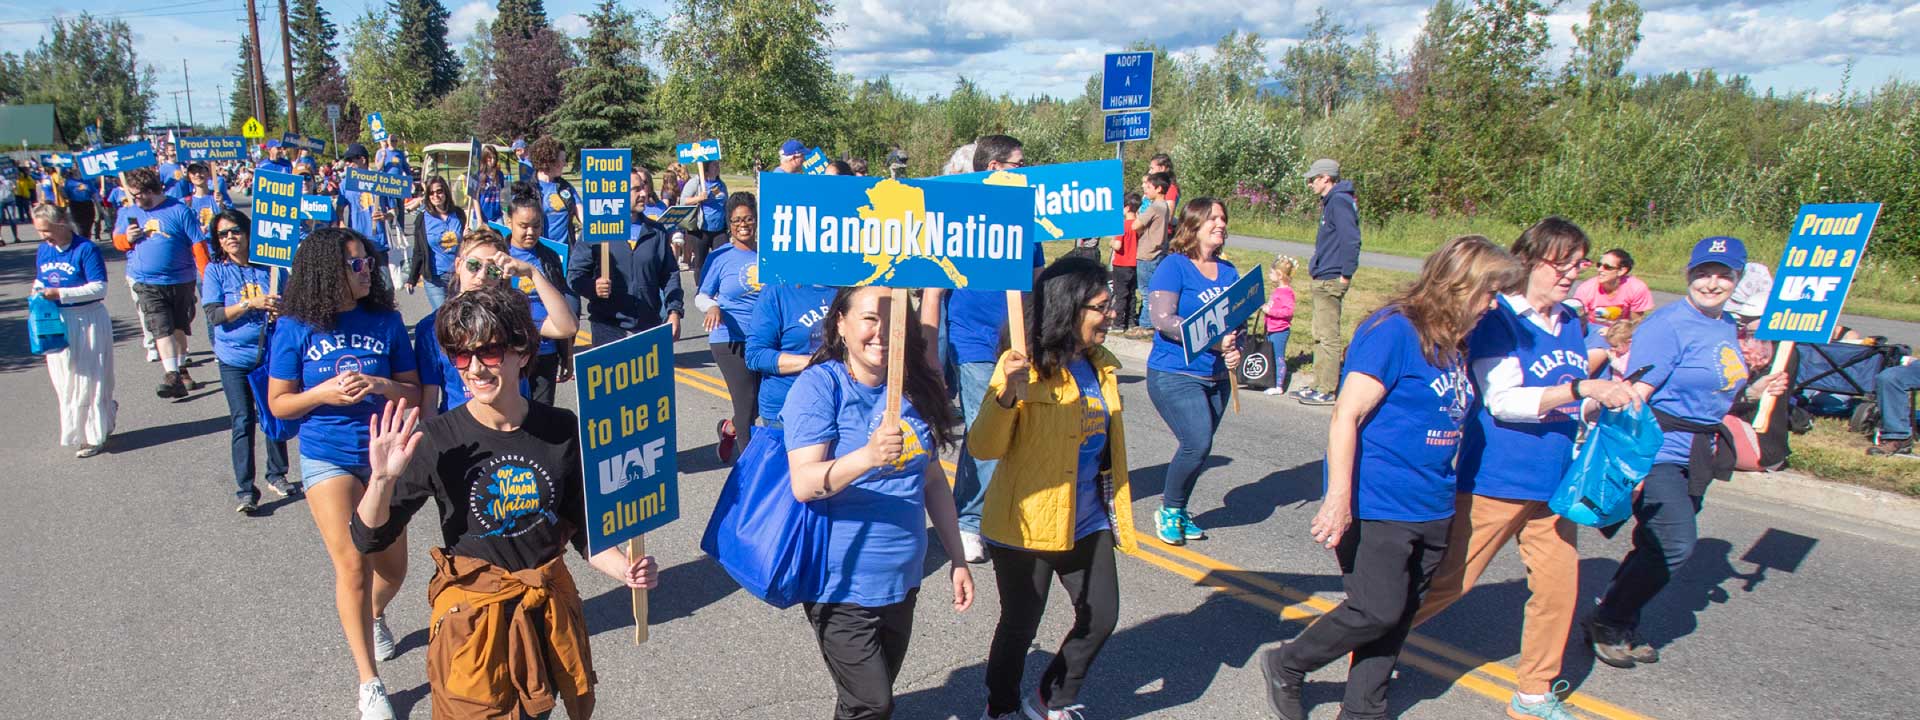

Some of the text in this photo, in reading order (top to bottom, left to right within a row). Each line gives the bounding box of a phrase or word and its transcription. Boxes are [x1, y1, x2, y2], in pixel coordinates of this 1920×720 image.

[1116, 55, 1142, 68] ADOPT
[1125, 75, 1131, 88] A
[1110, 94, 1144, 108] HIGHWAY
[1112, 115, 1142, 127] Fairbanks
[1129, 126, 1148, 137] Lions
[180, 139, 209, 148] Proud
[211, 140, 220, 148] to
[222, 139, 234, 148] be
[209, 148, 237, 158] Alum!
[81, 151, 119, 175] UAF
[586, 156, 623, 171] Proud
[258, 176, 295, 197] Proud
[351, 170, 378, 182] Proud
[380, 175, 389, 183] to
[391, 176, 401, 186] be
[585, 178, 628, 193] to be a
[375, 184, 402, 195] Alum!
[255, 199, 298, 219] to be a
[589, 199, 625, 215] UAF
[257, 220, 294, 240] UAF
[589, 219, 625, 234] alum!
[771, 204, 1024, 260] #NanookNation
[1798, 212, 1863, 236] Proud
[256, 242, 292, 260] alum!
[1785, 245, 1857, 267] to be a
[1778, 276, 1842, 301] UAF
[1188, 296, 1230, 353] UAF
[1768, 308, 1829, 331] alum!
[307, 334, 385, 361] UAF CTC
[587, 344, 660, 400] Proud
[1530, 350, 1566, 378] UAF
[588, 395, 671, 450] to be a
[489, 454, 525, 467] ALASKA
[598, 437, 666, 495] UAF
[499, 477, 538, 497] Nanook
[512, 471, 534, 483] are
[493, 496, 540, 520] Nation
[602, 483, 667, 537] alum!
